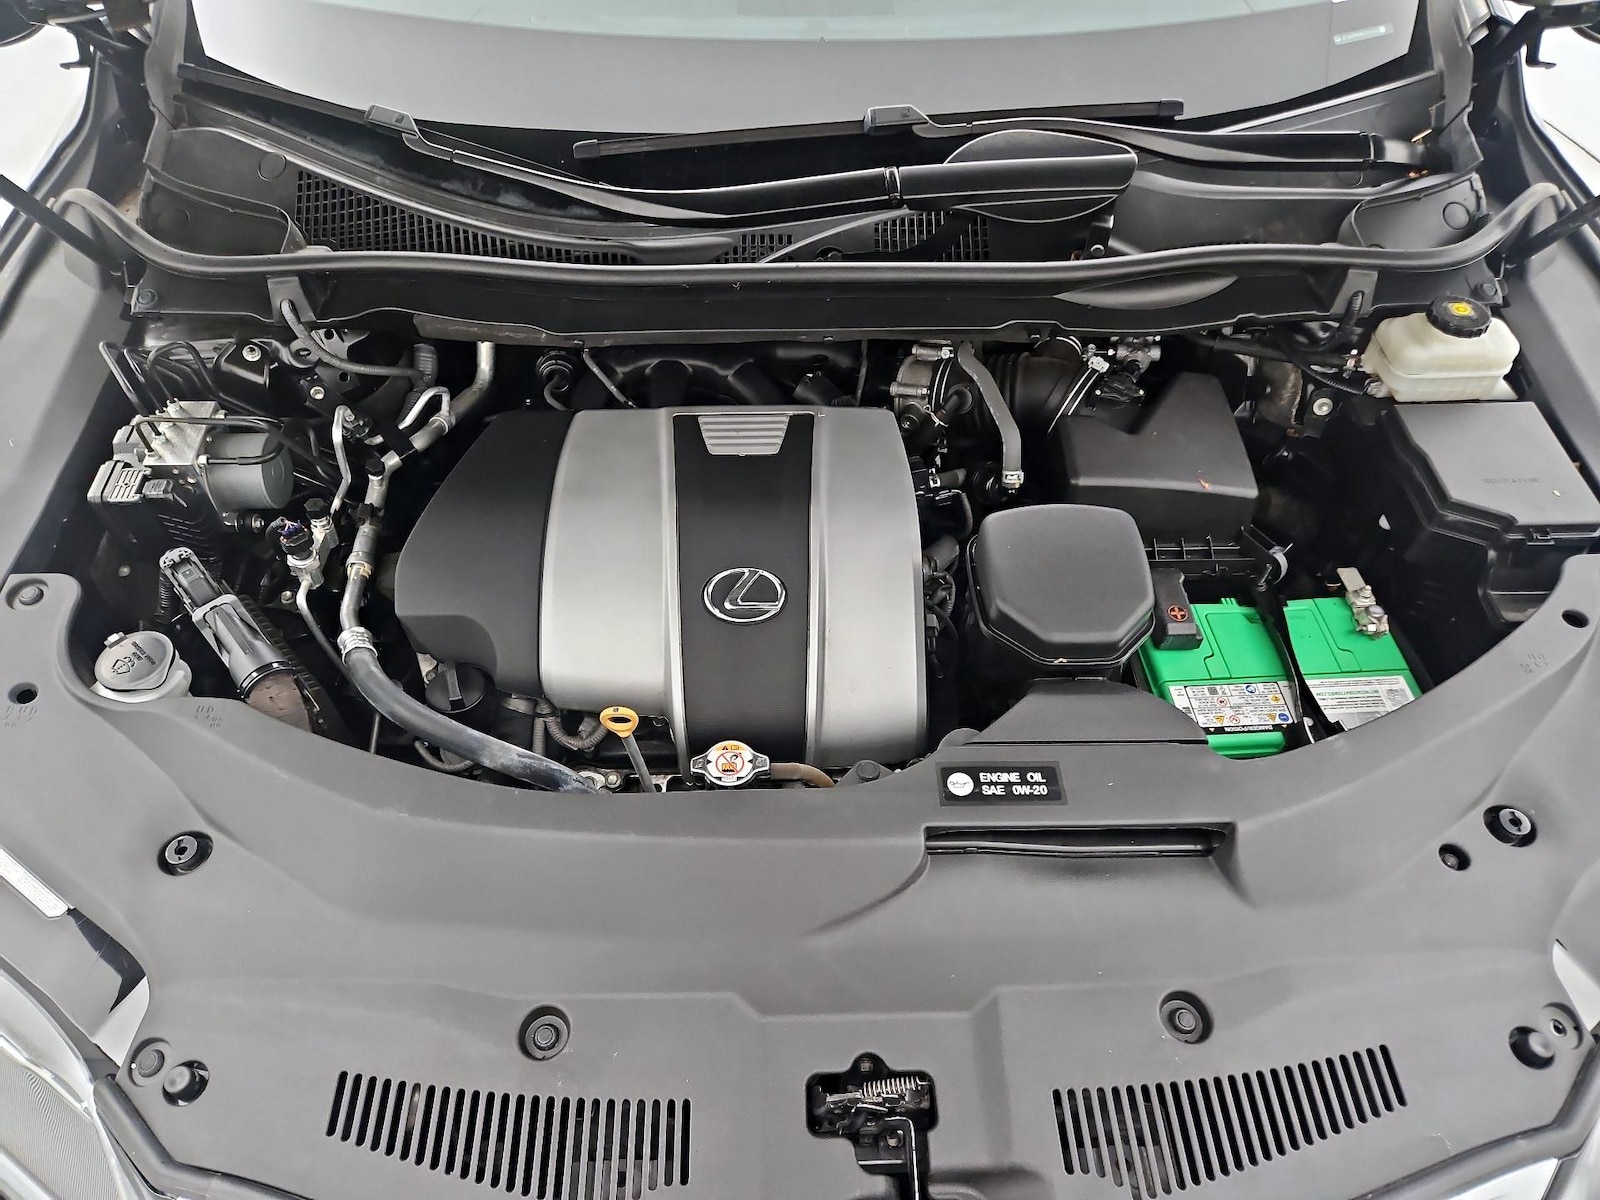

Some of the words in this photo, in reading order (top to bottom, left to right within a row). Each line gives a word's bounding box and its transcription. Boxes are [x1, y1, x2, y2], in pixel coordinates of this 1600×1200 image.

[979, 772, 1021, 783] ENGINE
[1026, 772, 1046, 783] OIL
[982, 785, 1006, 795] SAE
[1012, 785, 1048, 795] 0W-20
